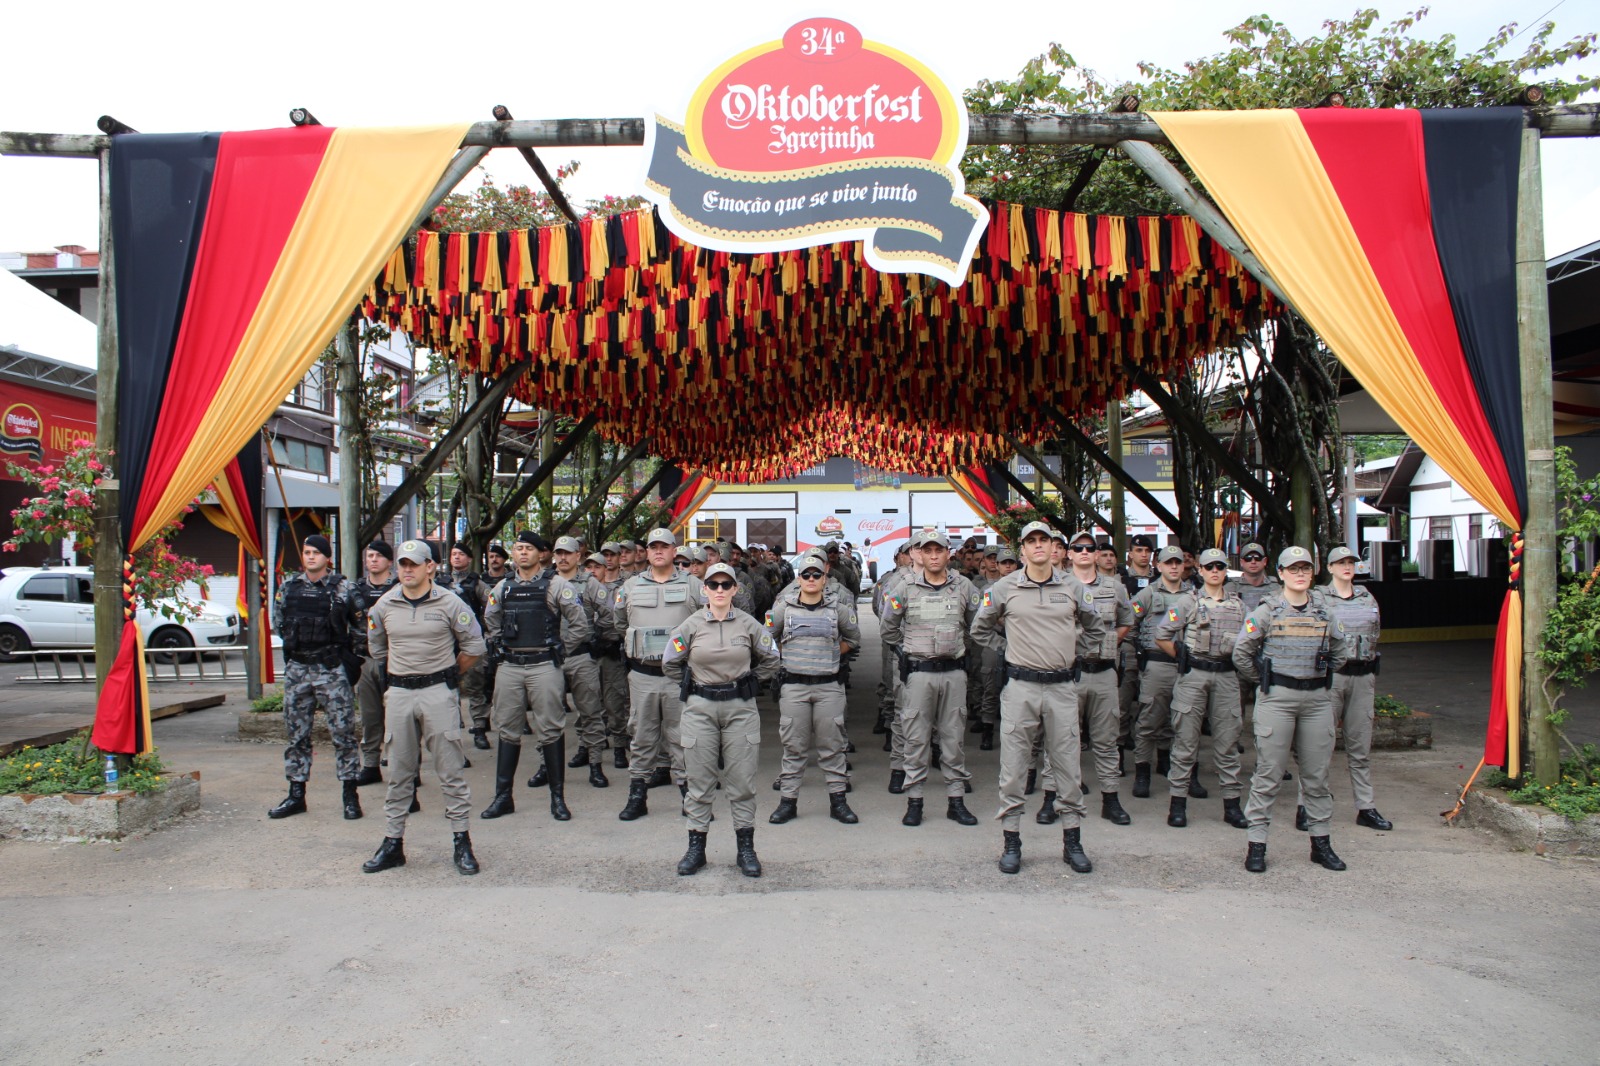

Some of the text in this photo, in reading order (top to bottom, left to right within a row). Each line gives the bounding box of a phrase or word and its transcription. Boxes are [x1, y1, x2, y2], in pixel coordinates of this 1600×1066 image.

[721, 83, 923, 129] Oktoberfest
[768, 125, 875, 154] Igrejinha
[702, 181, 917, 216] Emoção que se vive junto
[858, 518, 896, 532] Coca-Cola
